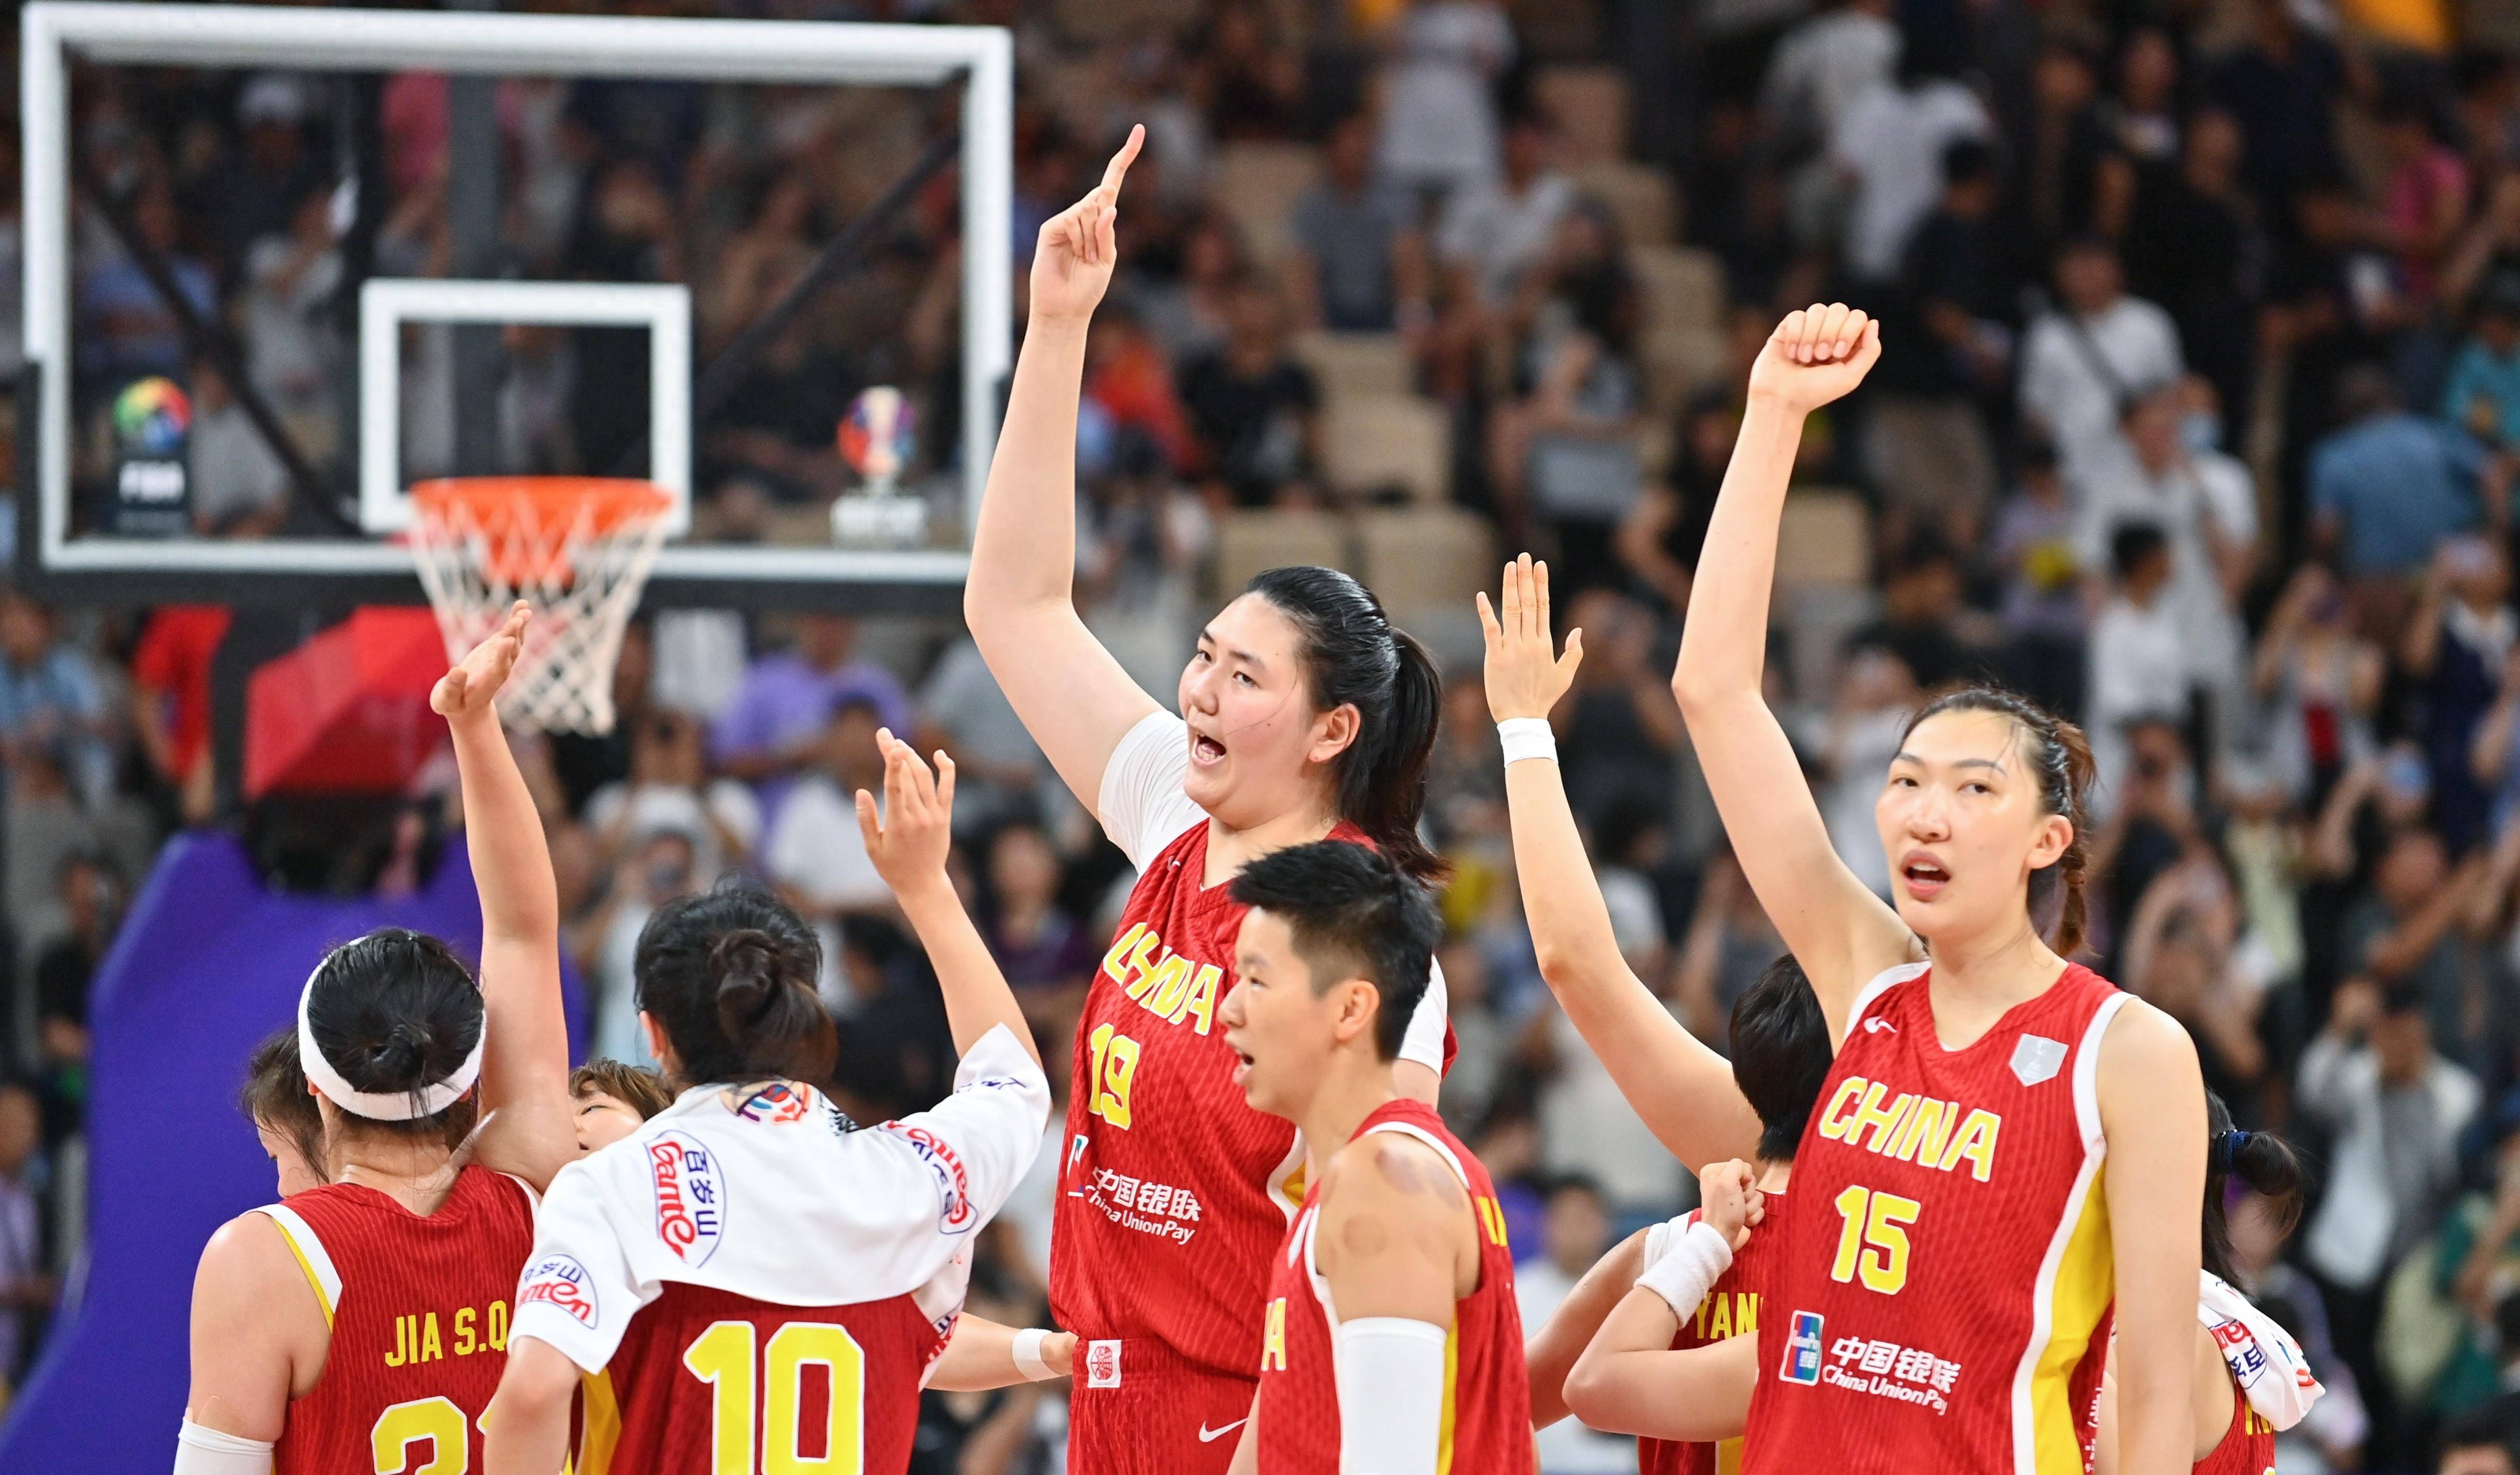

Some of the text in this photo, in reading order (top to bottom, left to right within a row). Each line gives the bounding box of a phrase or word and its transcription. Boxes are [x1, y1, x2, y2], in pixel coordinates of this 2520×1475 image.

[1088, 1023, 1140, 1131] 19
[1818, 1076, 2001, 1183] CHINA
[651, 1141, 695, 1261] Gante
[1092, 1166, 1202, 1222] 中国银联
[1122, 1209, 1195, 1245] UnionPay
[1831, 1185, 1921, 1295] 15
[385, 1312, 444, 1368] JIA
[1696, 1292, 1764, 1340] YAN
[1822, 1364, 1948, 1416] China UnionPay
[1830, 1336, 1962, 1394] 中国银联
[683, 1320, 866, 1475] 10
